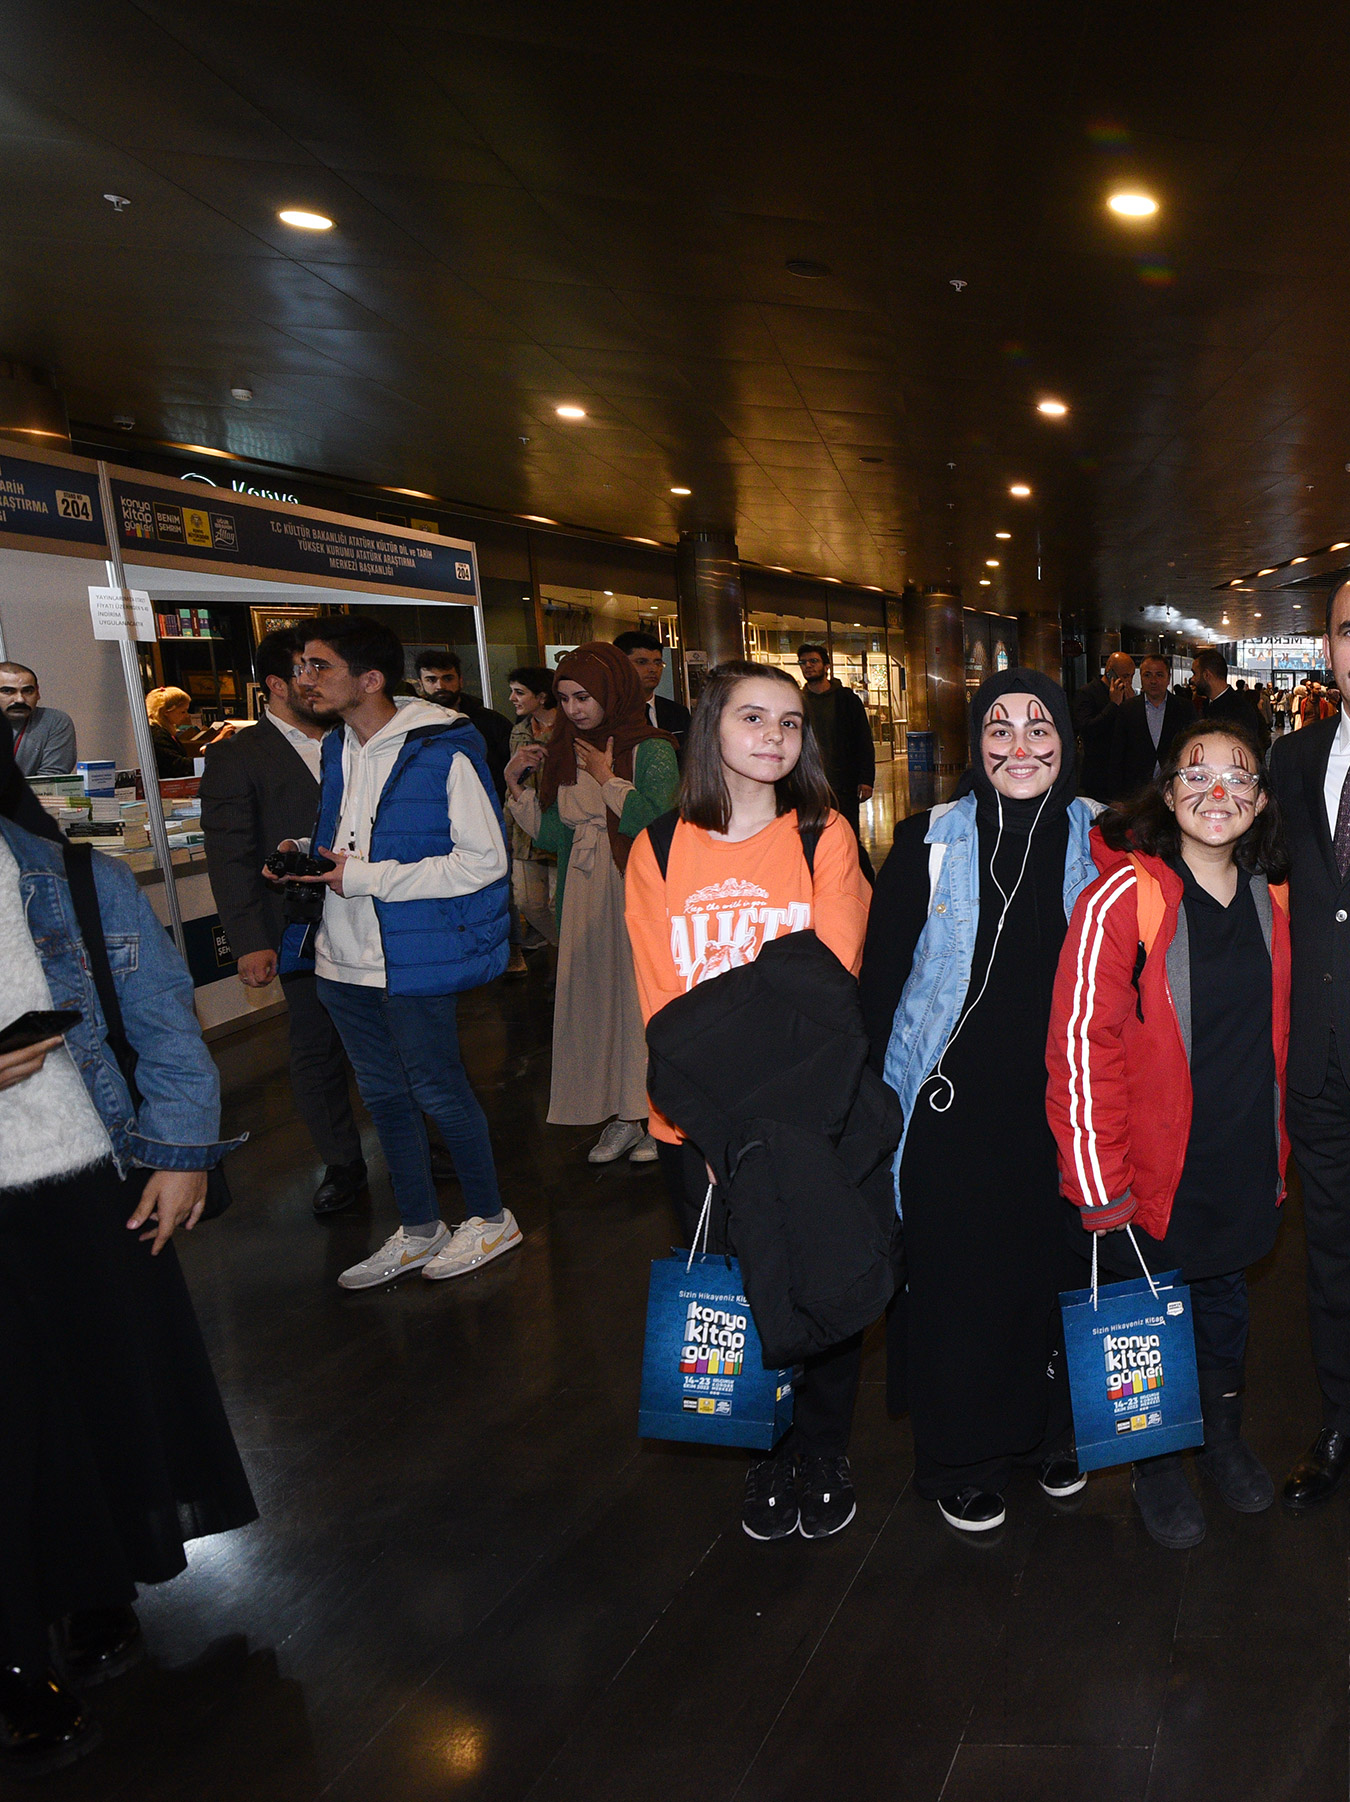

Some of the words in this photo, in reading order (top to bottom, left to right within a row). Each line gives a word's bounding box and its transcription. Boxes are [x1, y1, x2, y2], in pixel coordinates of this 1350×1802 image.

[62, 499, 90, 520] 204
[120, 496, 151, 512] konya
[122, 507, 152, 523] kitap
[283, 522, 311, 539] KÜLTÜR
[312, 529, 348, 545] BAKANLIĞI
[348, 535, 376, 549] ATATÜRK
[376, 539, 398, 553] KÜLTÜR
[297, 538, 325, 554] YÜKSEK
[326, 544, 355, 559] KURUMU
[356, 549, 382, 564] ATATÜRK
[457, 567, 470, 580] 204
[679, 1290, 697, 1299] Sizin
[698, 1292, 735, 1302] Hikayeniz
[736, 1295, 748, 1303] Kit
[687, 1301, 747, 1331] konya
[1092, 1327, 1110, 1335] Sizin
[1110, 1319, 1144, 1332] Hikayeniz
[1145, 1315, 1164, 1325] Kitap
[684, 1319, 745, 1351] kitap
[1103, 1334, 1160, 1352] konya
[681, 1344, 744, 1364] günleri
[1105, 1349, 1162, 1372] kitap
[684, 1376, 711, 1385] 14-23
[1106, 1364, 1163, 1391] günleri
[1113, 1396, 1138, 1409] 14-23
